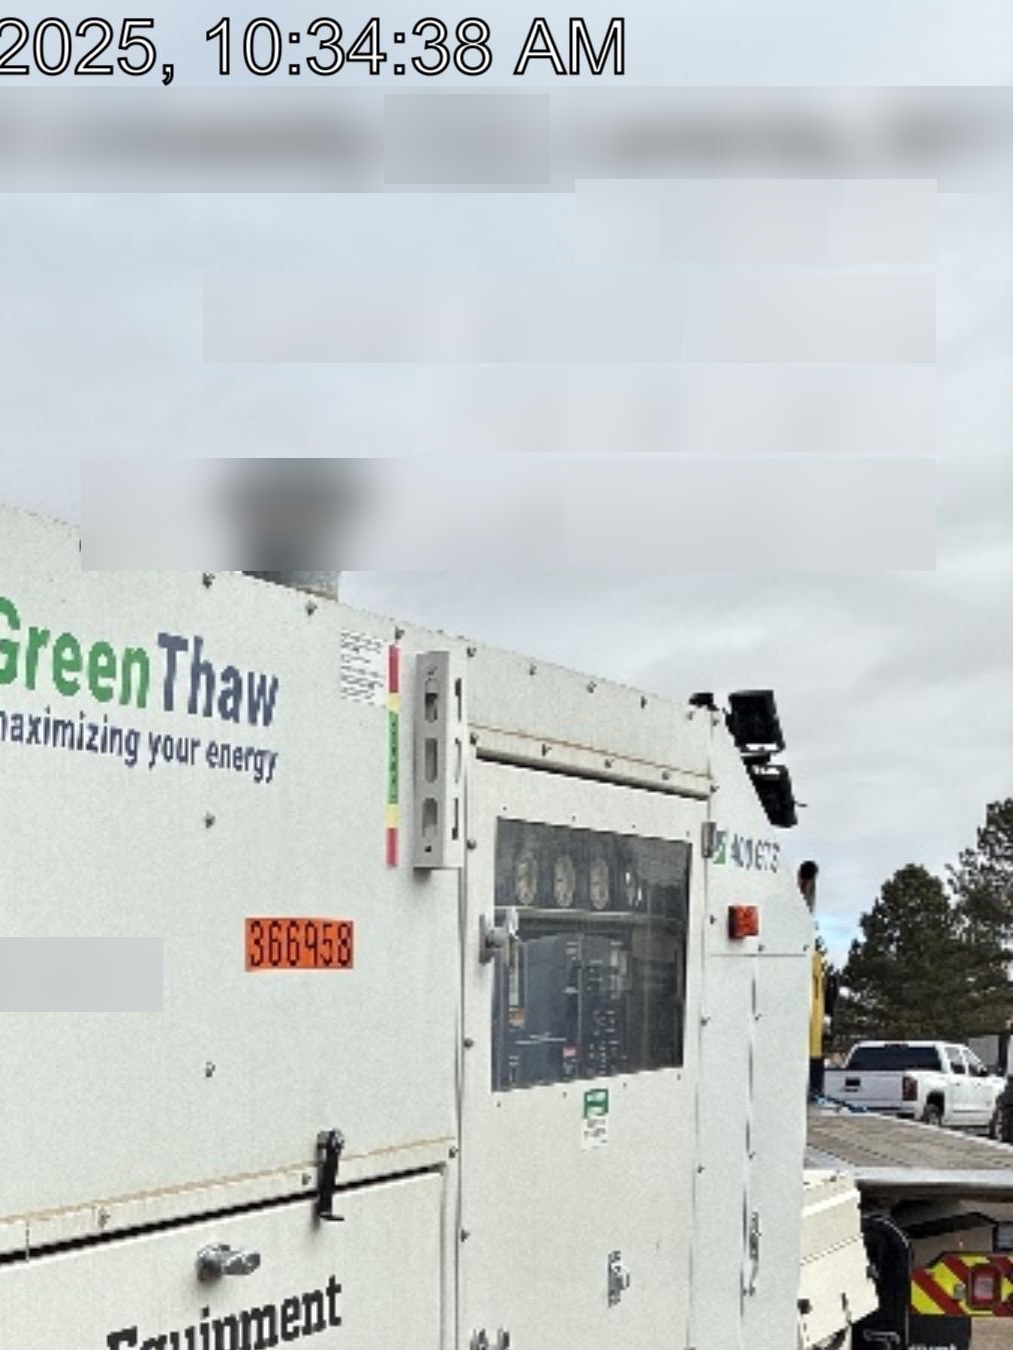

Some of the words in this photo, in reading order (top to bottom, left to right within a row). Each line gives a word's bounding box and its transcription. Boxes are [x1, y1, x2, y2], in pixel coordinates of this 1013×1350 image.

[147, 731, 201, 771] your
[205, 740, 279, 784] energy
[249, 920, 352, 967] 366958
